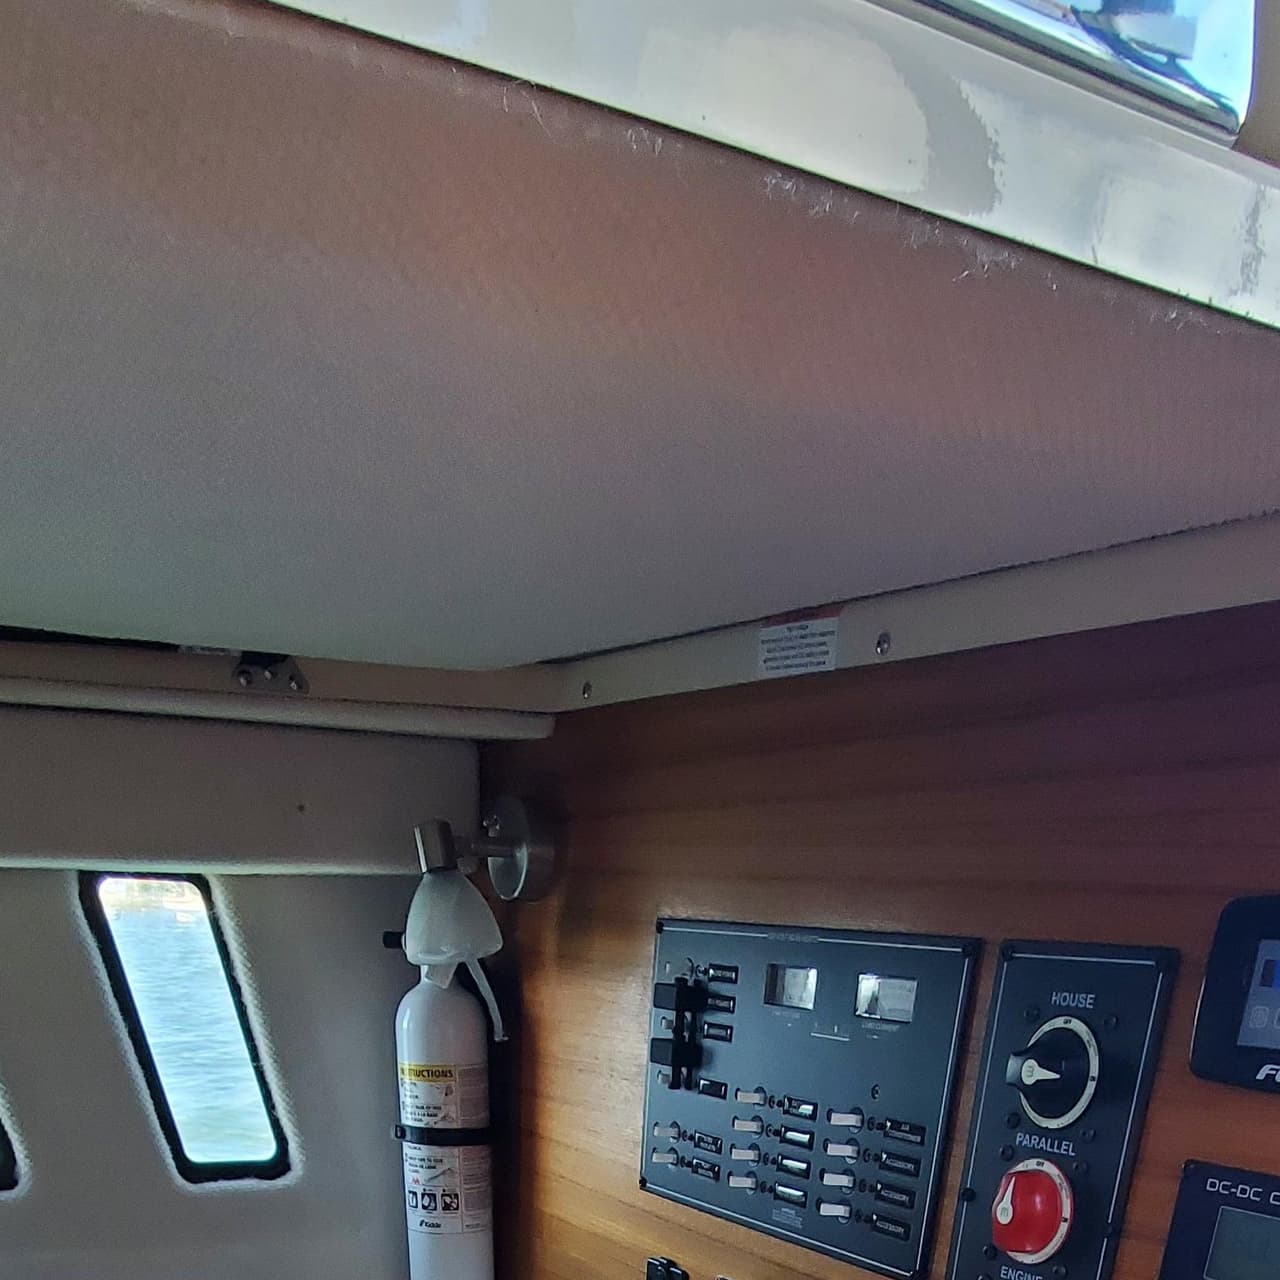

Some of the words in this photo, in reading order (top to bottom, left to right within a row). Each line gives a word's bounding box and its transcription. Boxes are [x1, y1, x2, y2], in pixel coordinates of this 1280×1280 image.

[1051, 991, 1096, 1009] HOUSE
[1016, 1132, 1076, 1156] PARALLEL
[1206, 1178, 1264, 1201] DC-DC
